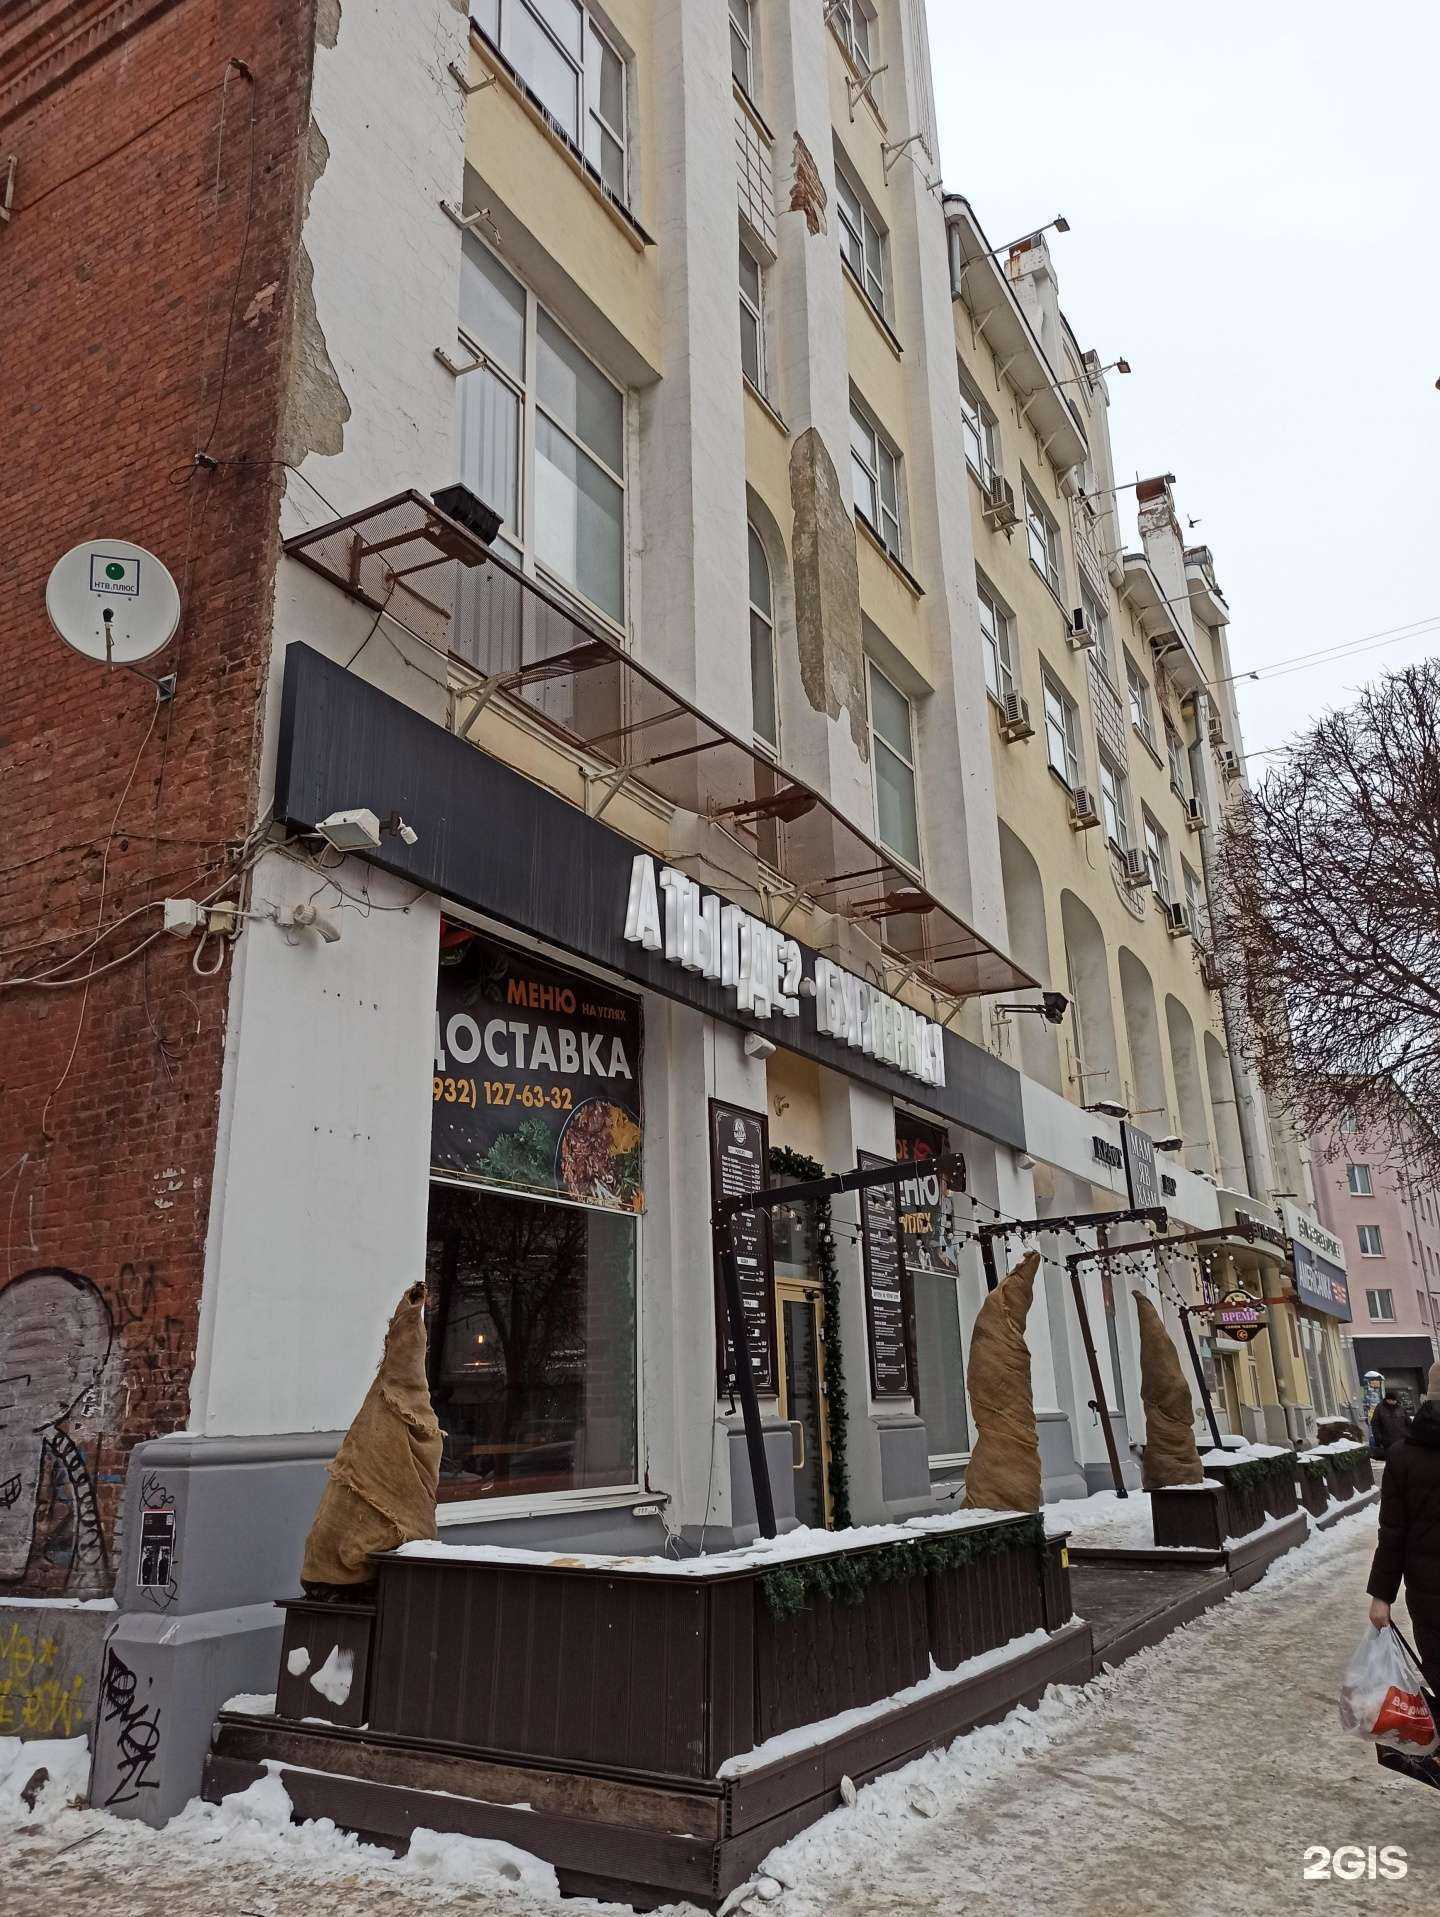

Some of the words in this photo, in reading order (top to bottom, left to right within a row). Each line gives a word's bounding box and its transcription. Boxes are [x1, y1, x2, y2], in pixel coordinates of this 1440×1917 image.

[507, 978, 577, 1015] МЕНЮ
[582, 1002, 597, 1017] НА
[599, 1005, 627, 1022] УГЛЯХ
[484, 1080, 573, 1110] 127-63-32
[1221, 1310, 1259, 1323] ВРЕМЯ
